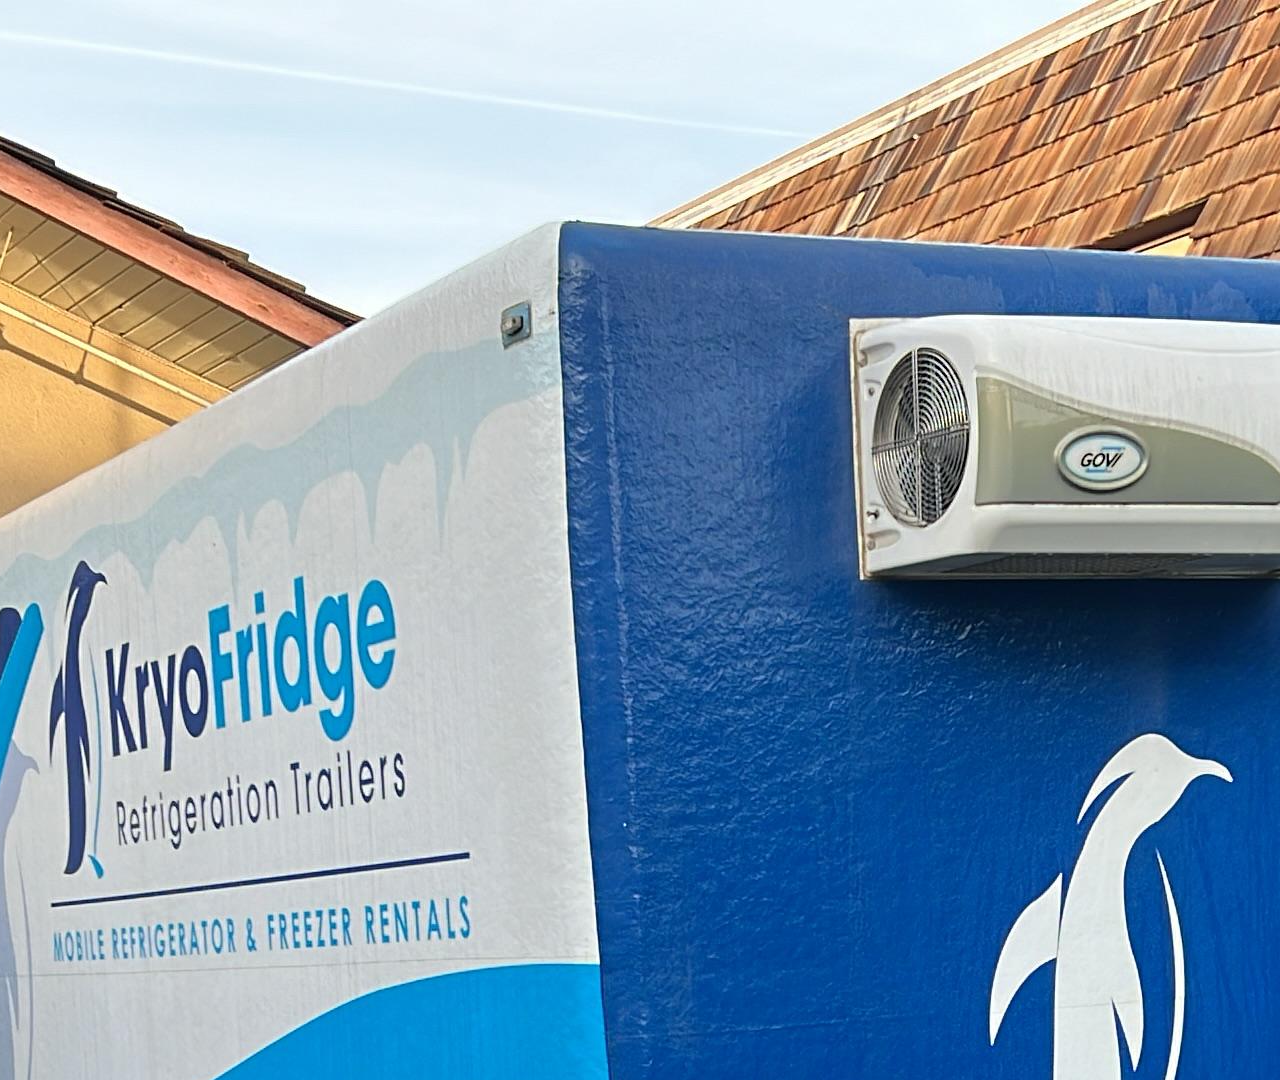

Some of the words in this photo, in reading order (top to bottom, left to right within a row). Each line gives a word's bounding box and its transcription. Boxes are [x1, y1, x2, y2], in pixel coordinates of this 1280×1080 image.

[105, 576, 396, 772] KryoFridge
[116, 774, 279, 849] Refrigeration
[290, 750, 406, 814] Trailers
[53, 929, 105, 961] MOBILE
[112, 918, 236, 960] REFRIGERATOR
[246, 917, 257, 951] &
[267, 907, 352, 950] FREEZER
[365, 895, 471, 944] RENTALS
